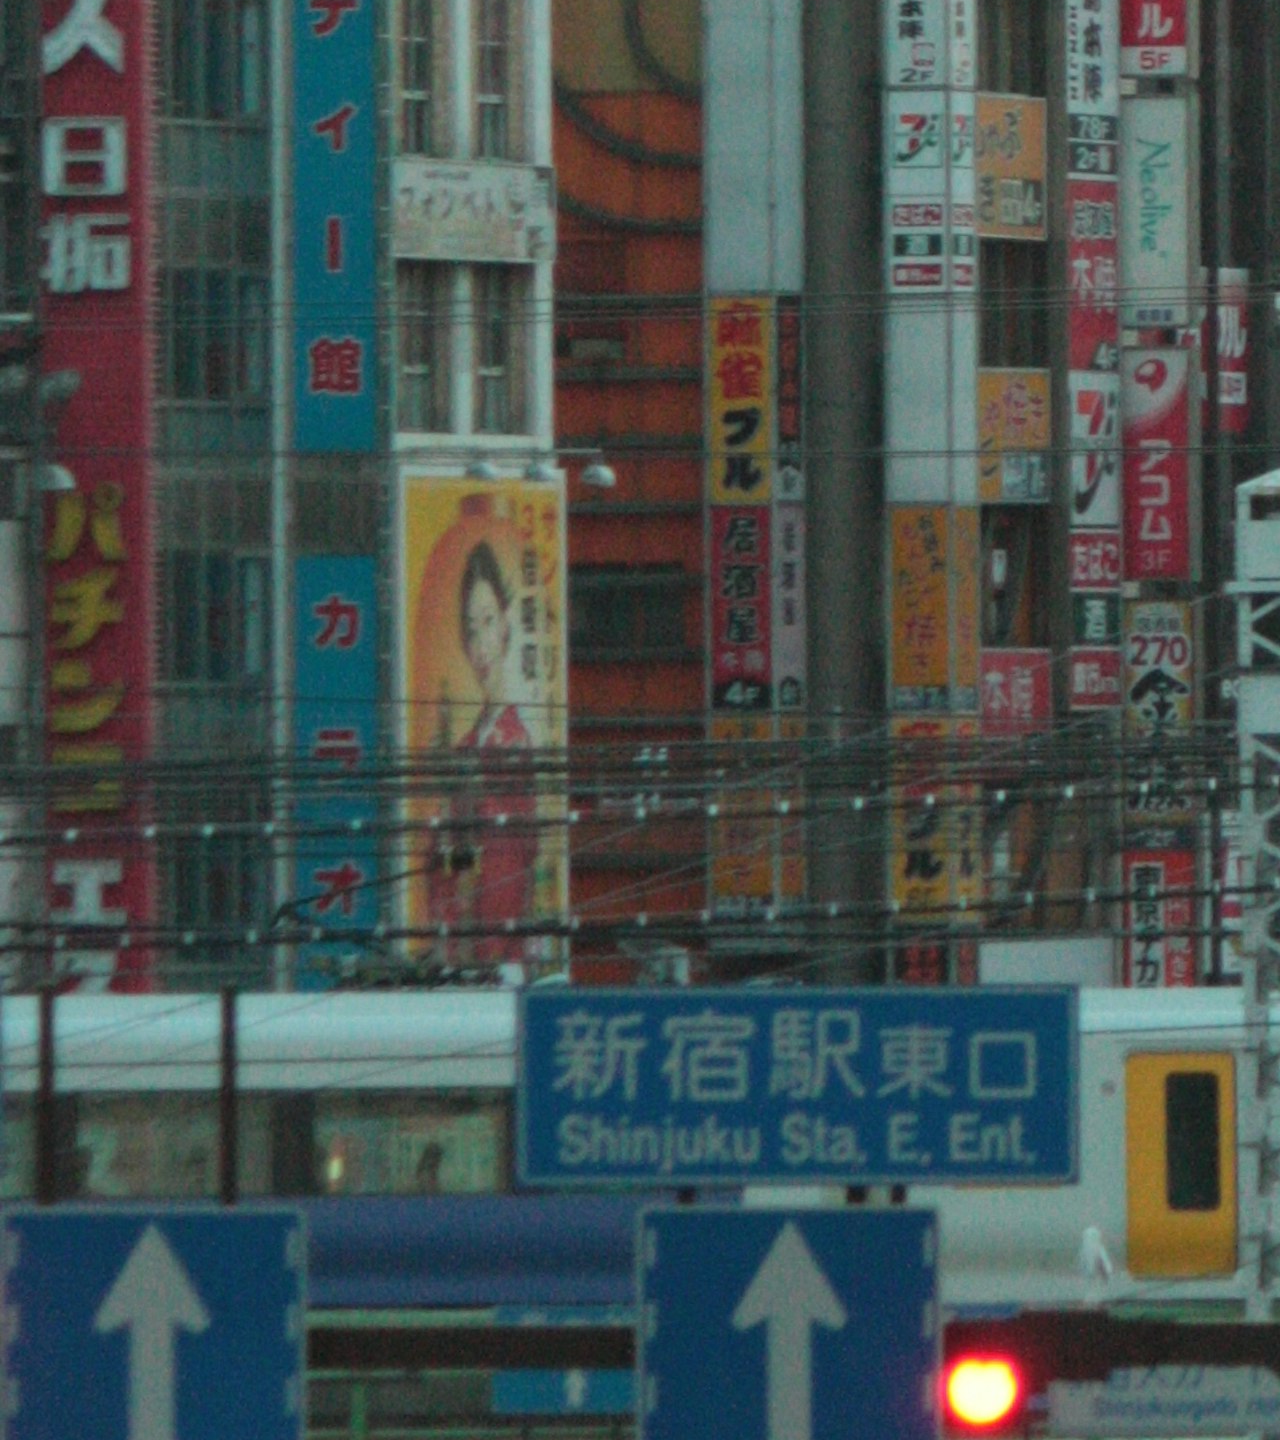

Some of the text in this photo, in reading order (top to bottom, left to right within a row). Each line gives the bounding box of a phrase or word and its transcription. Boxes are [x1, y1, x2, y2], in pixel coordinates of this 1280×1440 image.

[1137, 438, 1174, 542] アコム
[721, 515, 761, 645] 居酒屋
[1129, 635, 1190, 667] 270
[552, 1008, 1037, 1104] 新宿駅東口
[557, 1117, 1037, 1175] Shinjuku Sta. E. Ent.
